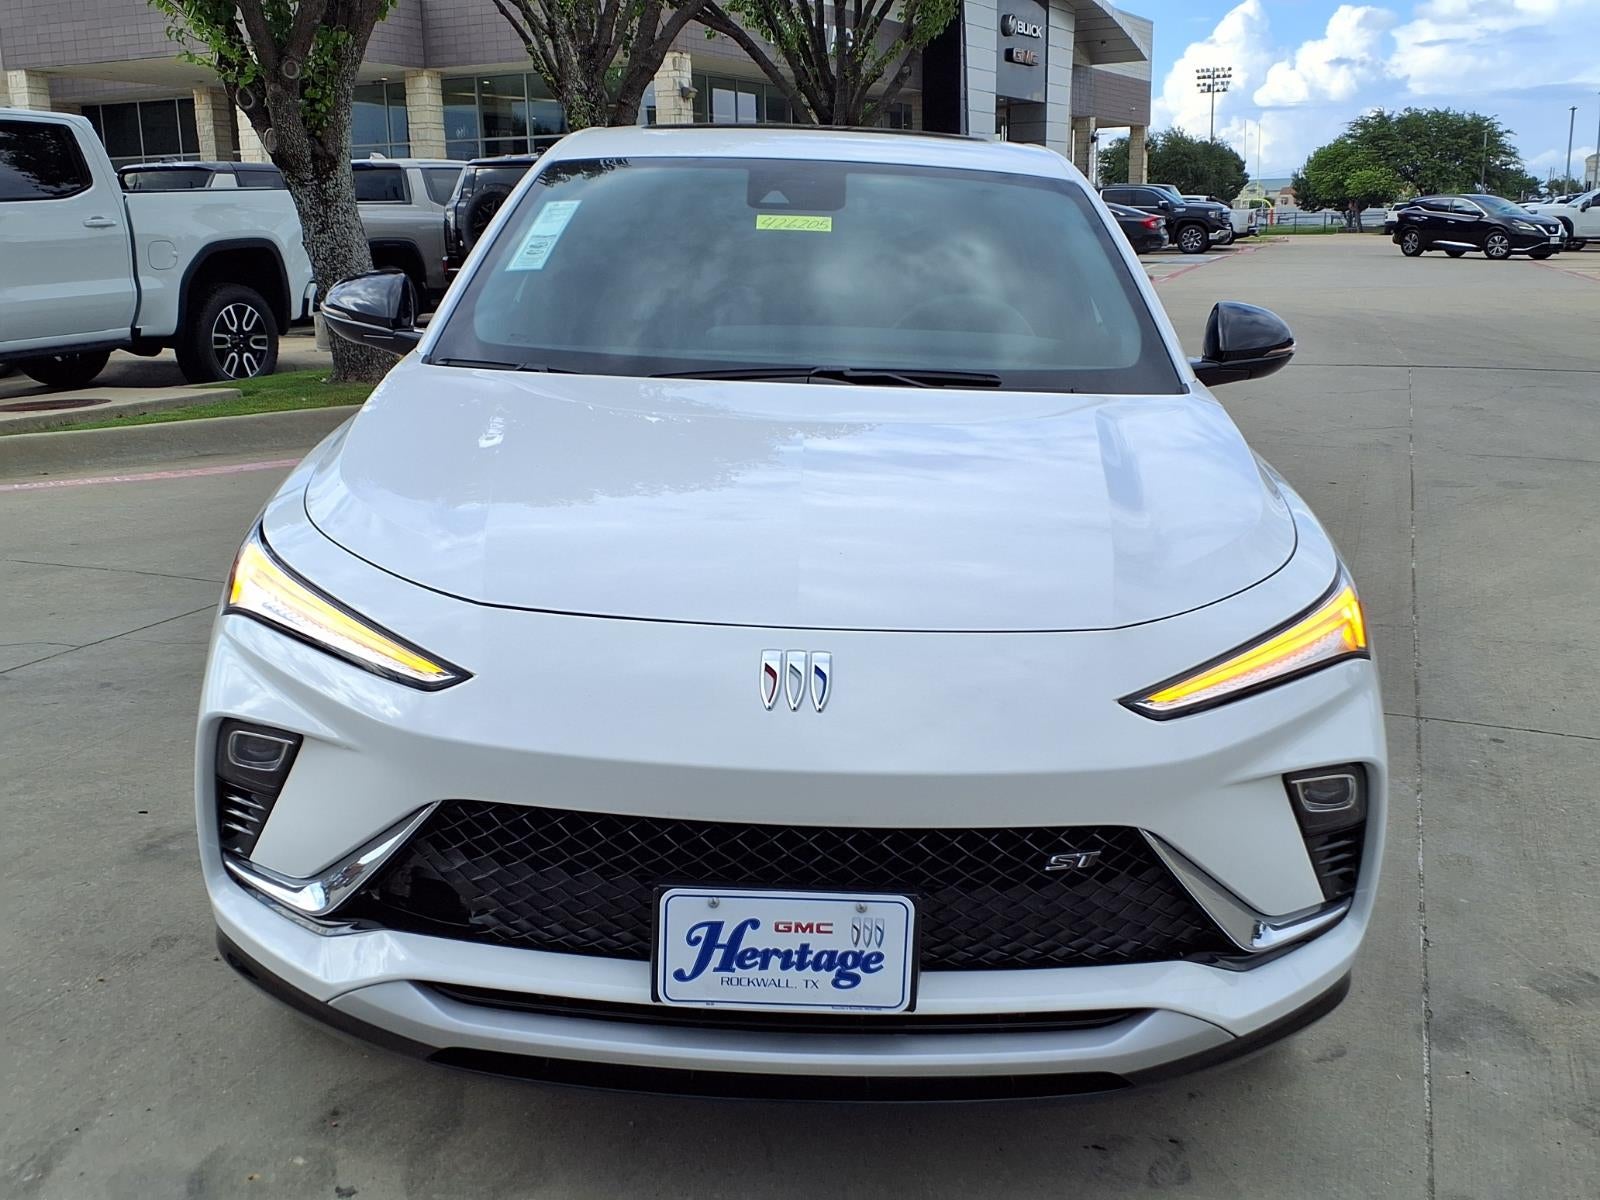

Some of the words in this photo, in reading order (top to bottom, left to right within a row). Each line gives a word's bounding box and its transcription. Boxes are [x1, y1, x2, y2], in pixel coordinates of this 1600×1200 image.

[1017, 20, 1042, 38] BUICK
[1045, 850, 1101, 871] ST
[774, 921, 834, 934] GMC
[673, 918, 885, 990] Heritage
[803, 978, 819, 989] TX
